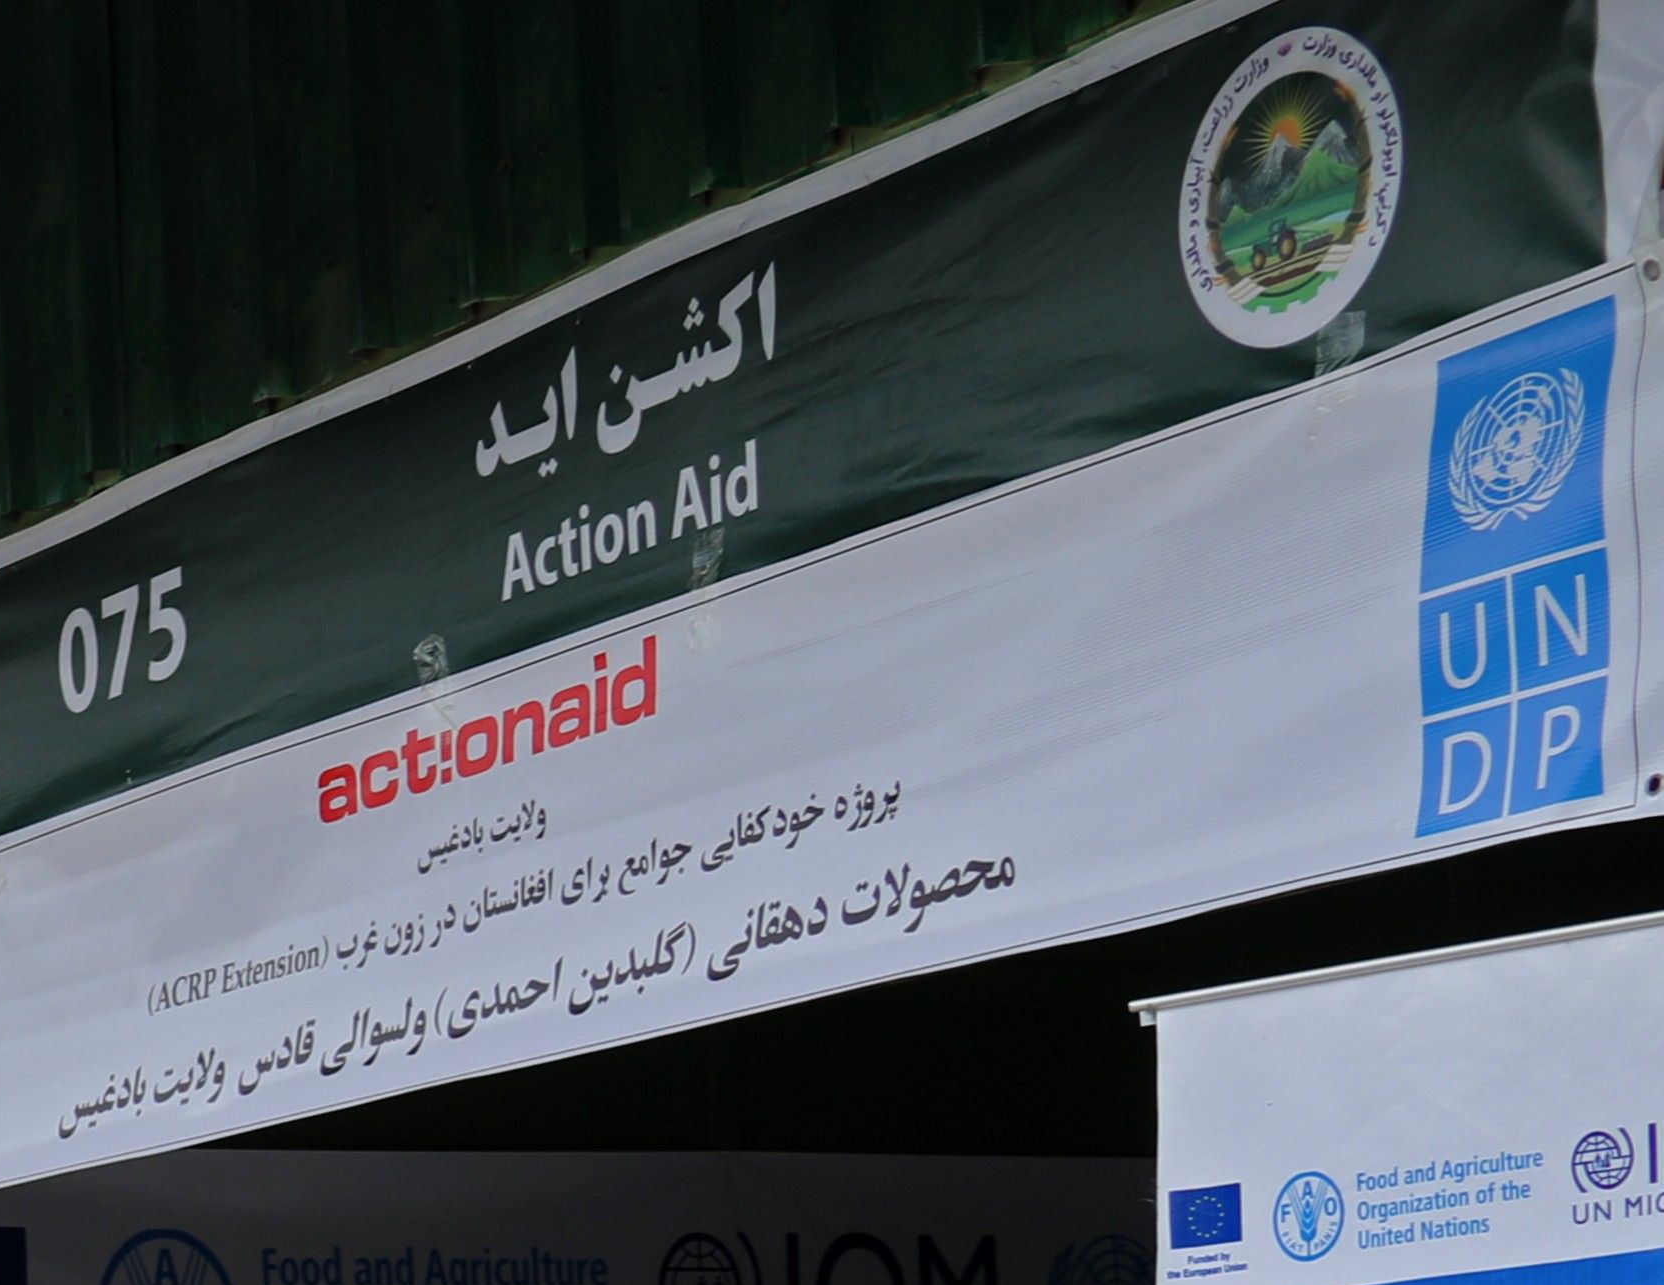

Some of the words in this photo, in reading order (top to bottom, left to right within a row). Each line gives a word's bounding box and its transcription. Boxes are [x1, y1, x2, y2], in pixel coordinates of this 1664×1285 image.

[502, 490, 656, 602] Action
[673, 439, 760, 541] Aid
[58, 566, 188, 714] 075
[317, 635, 657, 824] actionaid
[489, 800, 547, 839] ولایت
[834, 780, 902, 831] پروژه
[417, 817, 484, 873] بادغیس
[618, 838, 692, 896] جوامع
[462, 869, 554, 932] افغانستان
[560, 857, 611, 904] برای
[840, 850, 1015, 931] محصولات
[337, 922, 379, 970] غرب
[384, 915, 423, 955] زون
[431, 903, 456, 944] در
[707, 891, 828, 980] دهقانی
[147, 969, 216, 1017] (ACRP
[221, 935, 329, 994] Extension)
[238, 1019, 316, 1095] قادس
[319, 997, 427, 1076] ولسوالی
[58, 1067, 146, 1139] بادغیس
[153, 1047, 226, 1105] ولایت
[1356, 1170, 1398, 1192] Food
[1403, 1163, 1436, 1184] and
[1441, 1150, 1544, 1183] Agriculture
[1356, 1191, 1469, 1226] Organization
[1357, 1224, 1415, 1250] United
[1420, 1215, 1490, 1242] Nations
